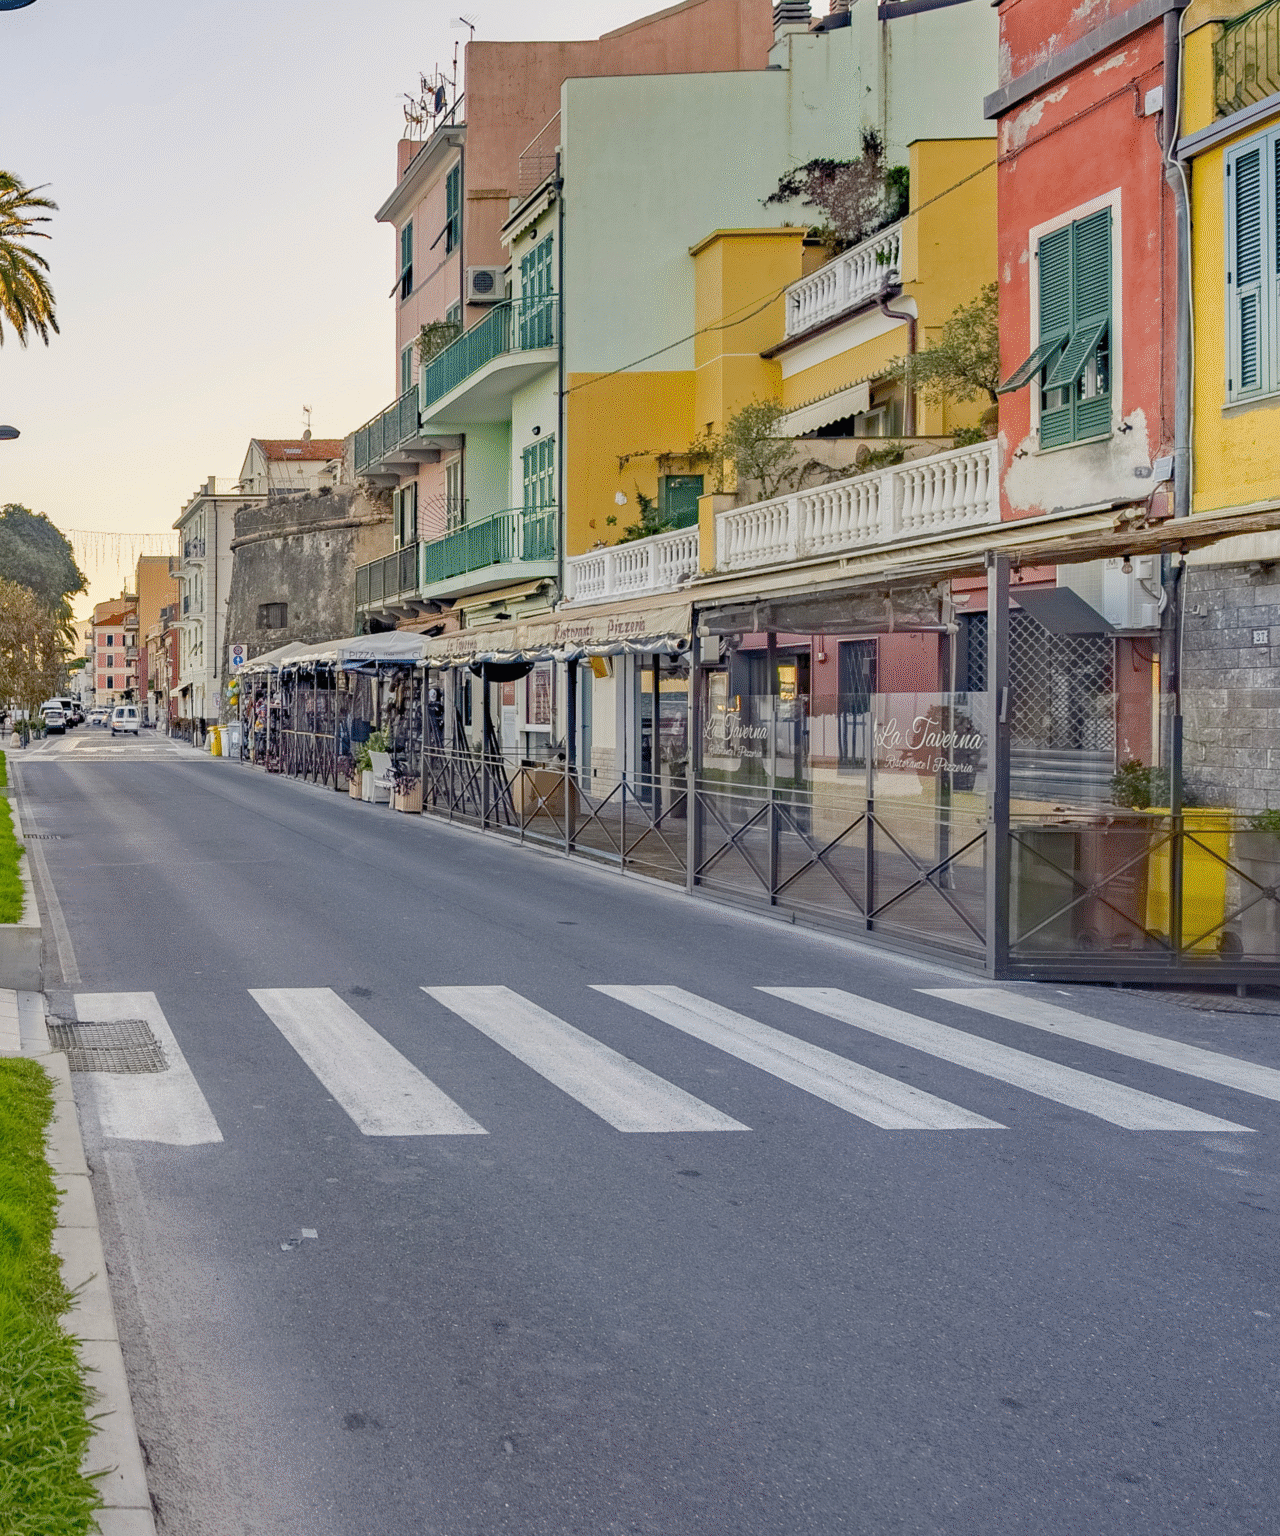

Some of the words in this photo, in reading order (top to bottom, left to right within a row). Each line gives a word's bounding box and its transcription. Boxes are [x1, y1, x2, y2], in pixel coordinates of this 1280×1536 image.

[607, 616, 646, 636] Pizzeria
[348, 651, 377, 660] PIZZA
[703, 715, 718, 740] La
[722, 713, 769, 741] Taverna
[876, 717, 903, 749] La
[905, 715, 985, 750] Taverna
[884, 754, 927, 770] Ristorante
[932, 756, 974, 773] Pizzeria
